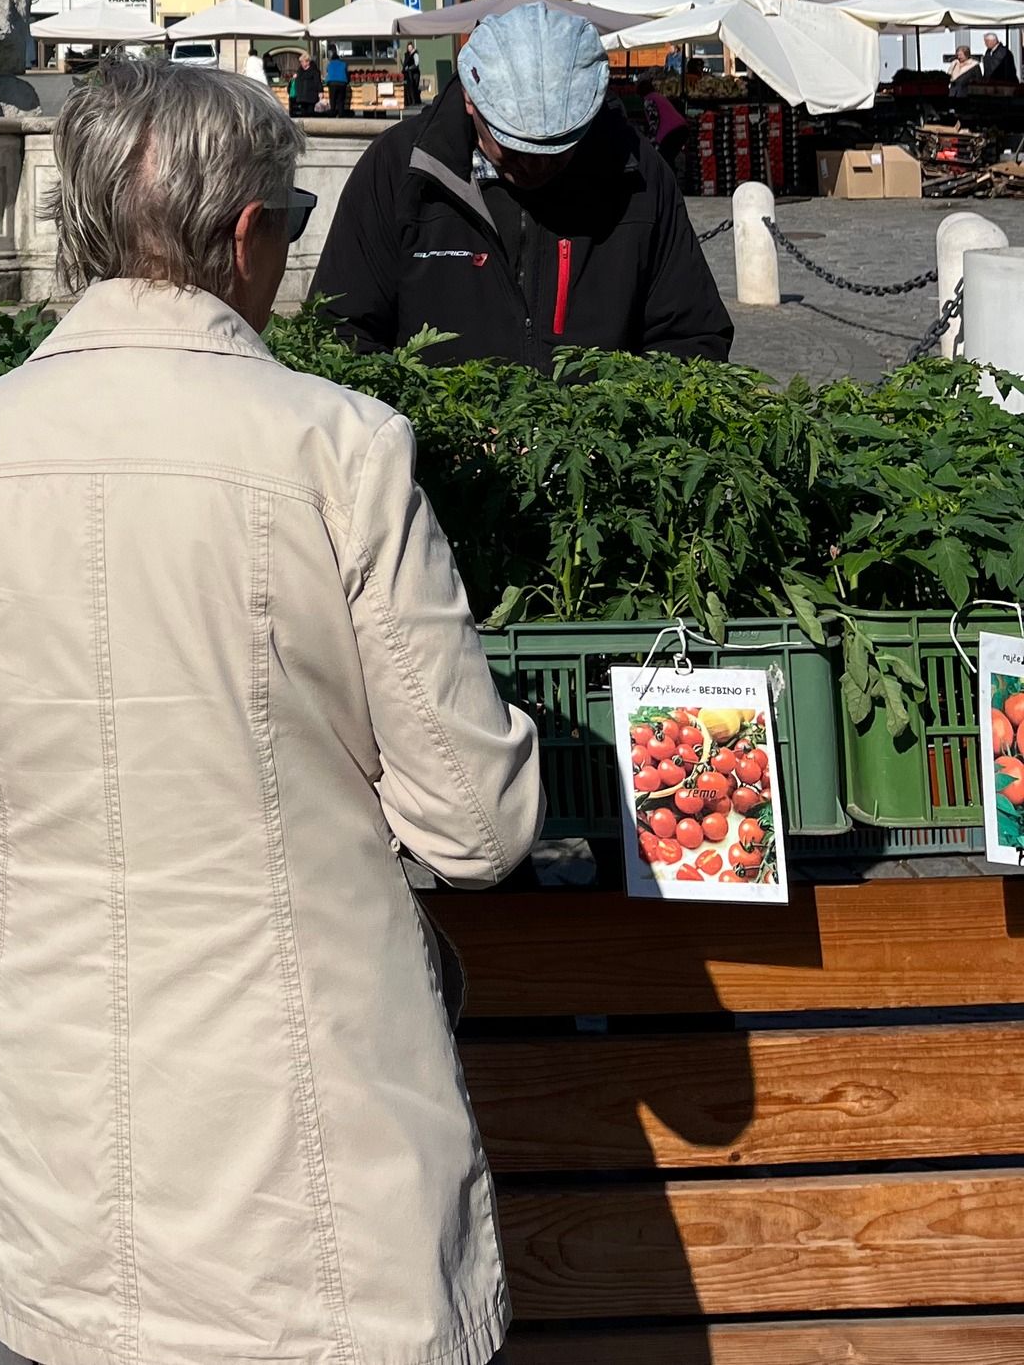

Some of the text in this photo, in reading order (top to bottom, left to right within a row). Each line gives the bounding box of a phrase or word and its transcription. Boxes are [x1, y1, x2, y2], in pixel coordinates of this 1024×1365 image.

[1002, 654, 1021, 664] rajče
[657, 685, 690, 695] tyčkové
[699, 686, 742, 695] BEJBINO
[745, 687, 756, 696] F1
[686, 789, 717, 799] semo
